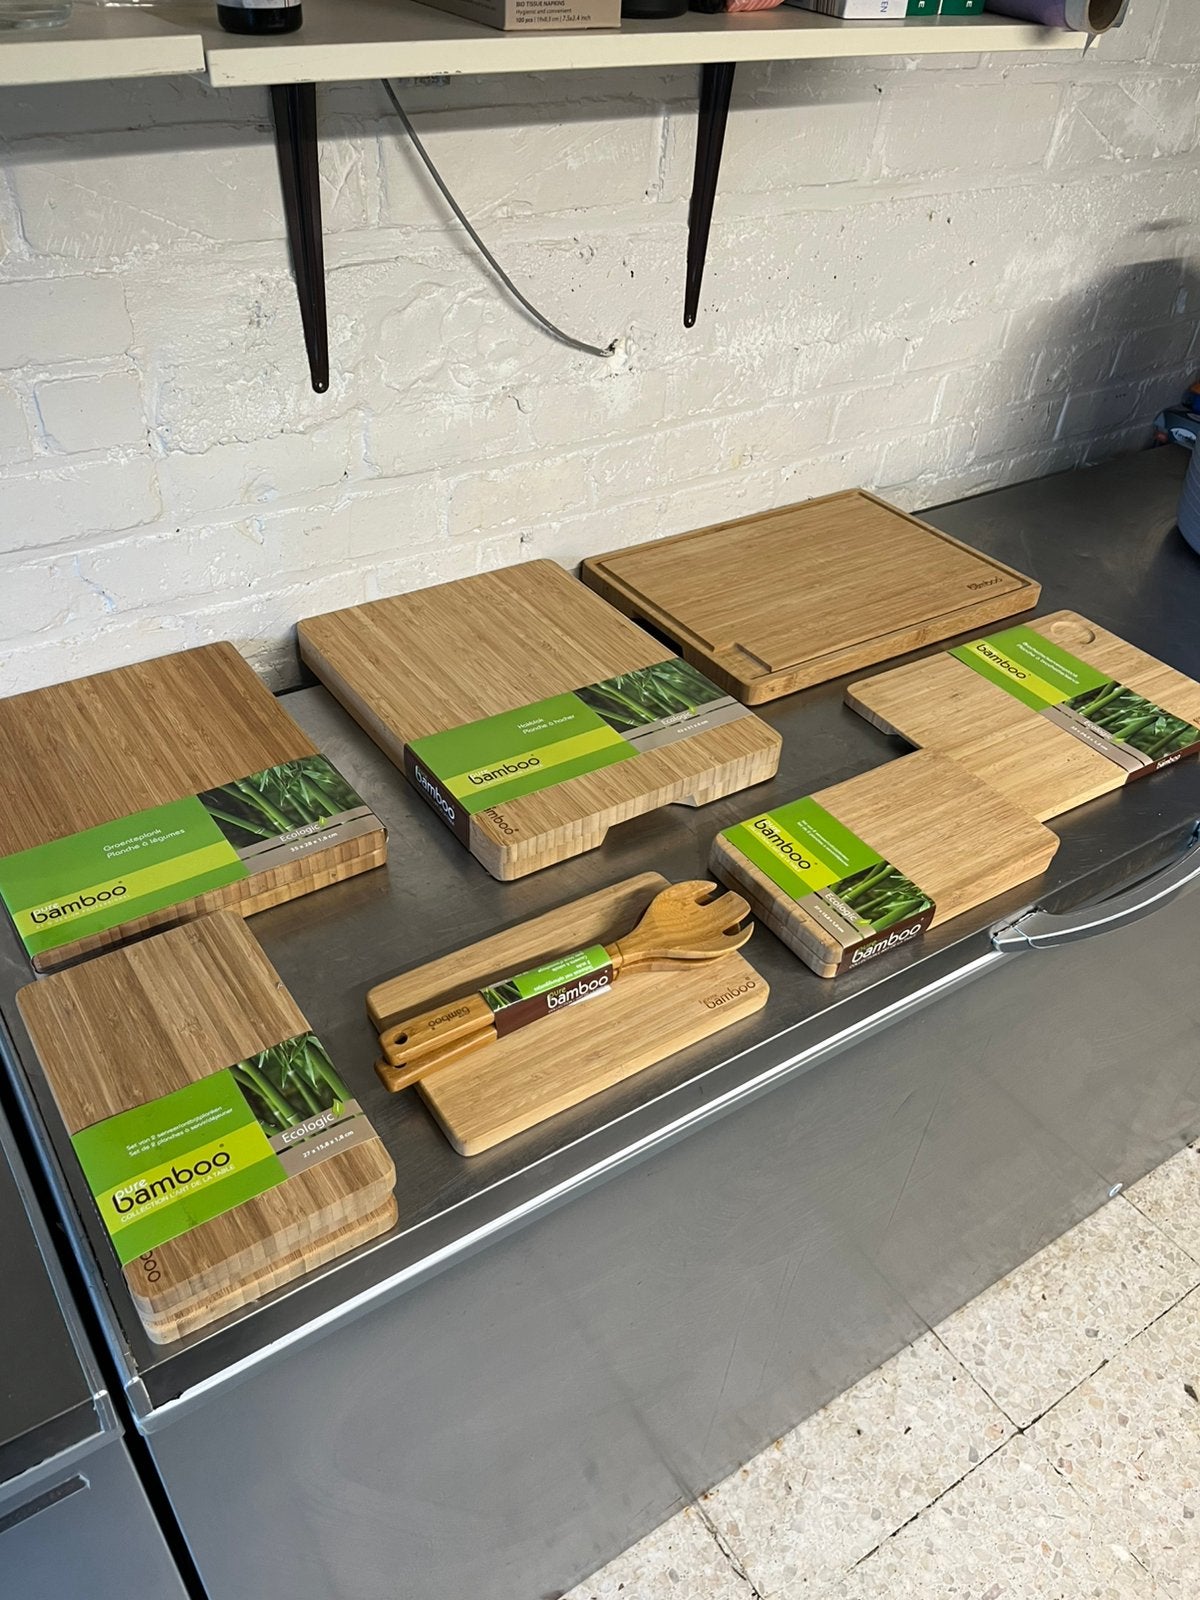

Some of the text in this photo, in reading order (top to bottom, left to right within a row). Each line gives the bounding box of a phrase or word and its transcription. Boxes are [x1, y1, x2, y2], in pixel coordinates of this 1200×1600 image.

[976, 643, 1027, 679] bamboo
[522, 723, 548, 734] Planche
[467, 757, 540, 785] bamboo
[415, 765, 456, 820] bamboo
[280, 823, 321, 842] Ecologic
[484, 807, 514, 835] mboo
[106, 843, 140, 859] Planche
[754, 818, 811, 870] bamboo
[30, 885, 127, 924] bamboo
[825, 892, 858, 922] Ecologic
[851, 923, 922, 964] bamboo
[546, 975, 609, 1009] bamboo
[549, 987, 566, 998] pure
[703, 980, 756, 1009] bamboo
[428, 1006, 471, 1027] bamboo
[281, 1113, 335, 1144] Ecologic
[111, 1151, 231, 1214] bamboo
[114, 1178, 148, 1204] pure
[120, 1194, 169, 1223] COLLECTION
[190, 1181, 202, 1189] DE
[203, 1176, 214, 1184] LA
[212, 1163, 236, 1178] TABLE
